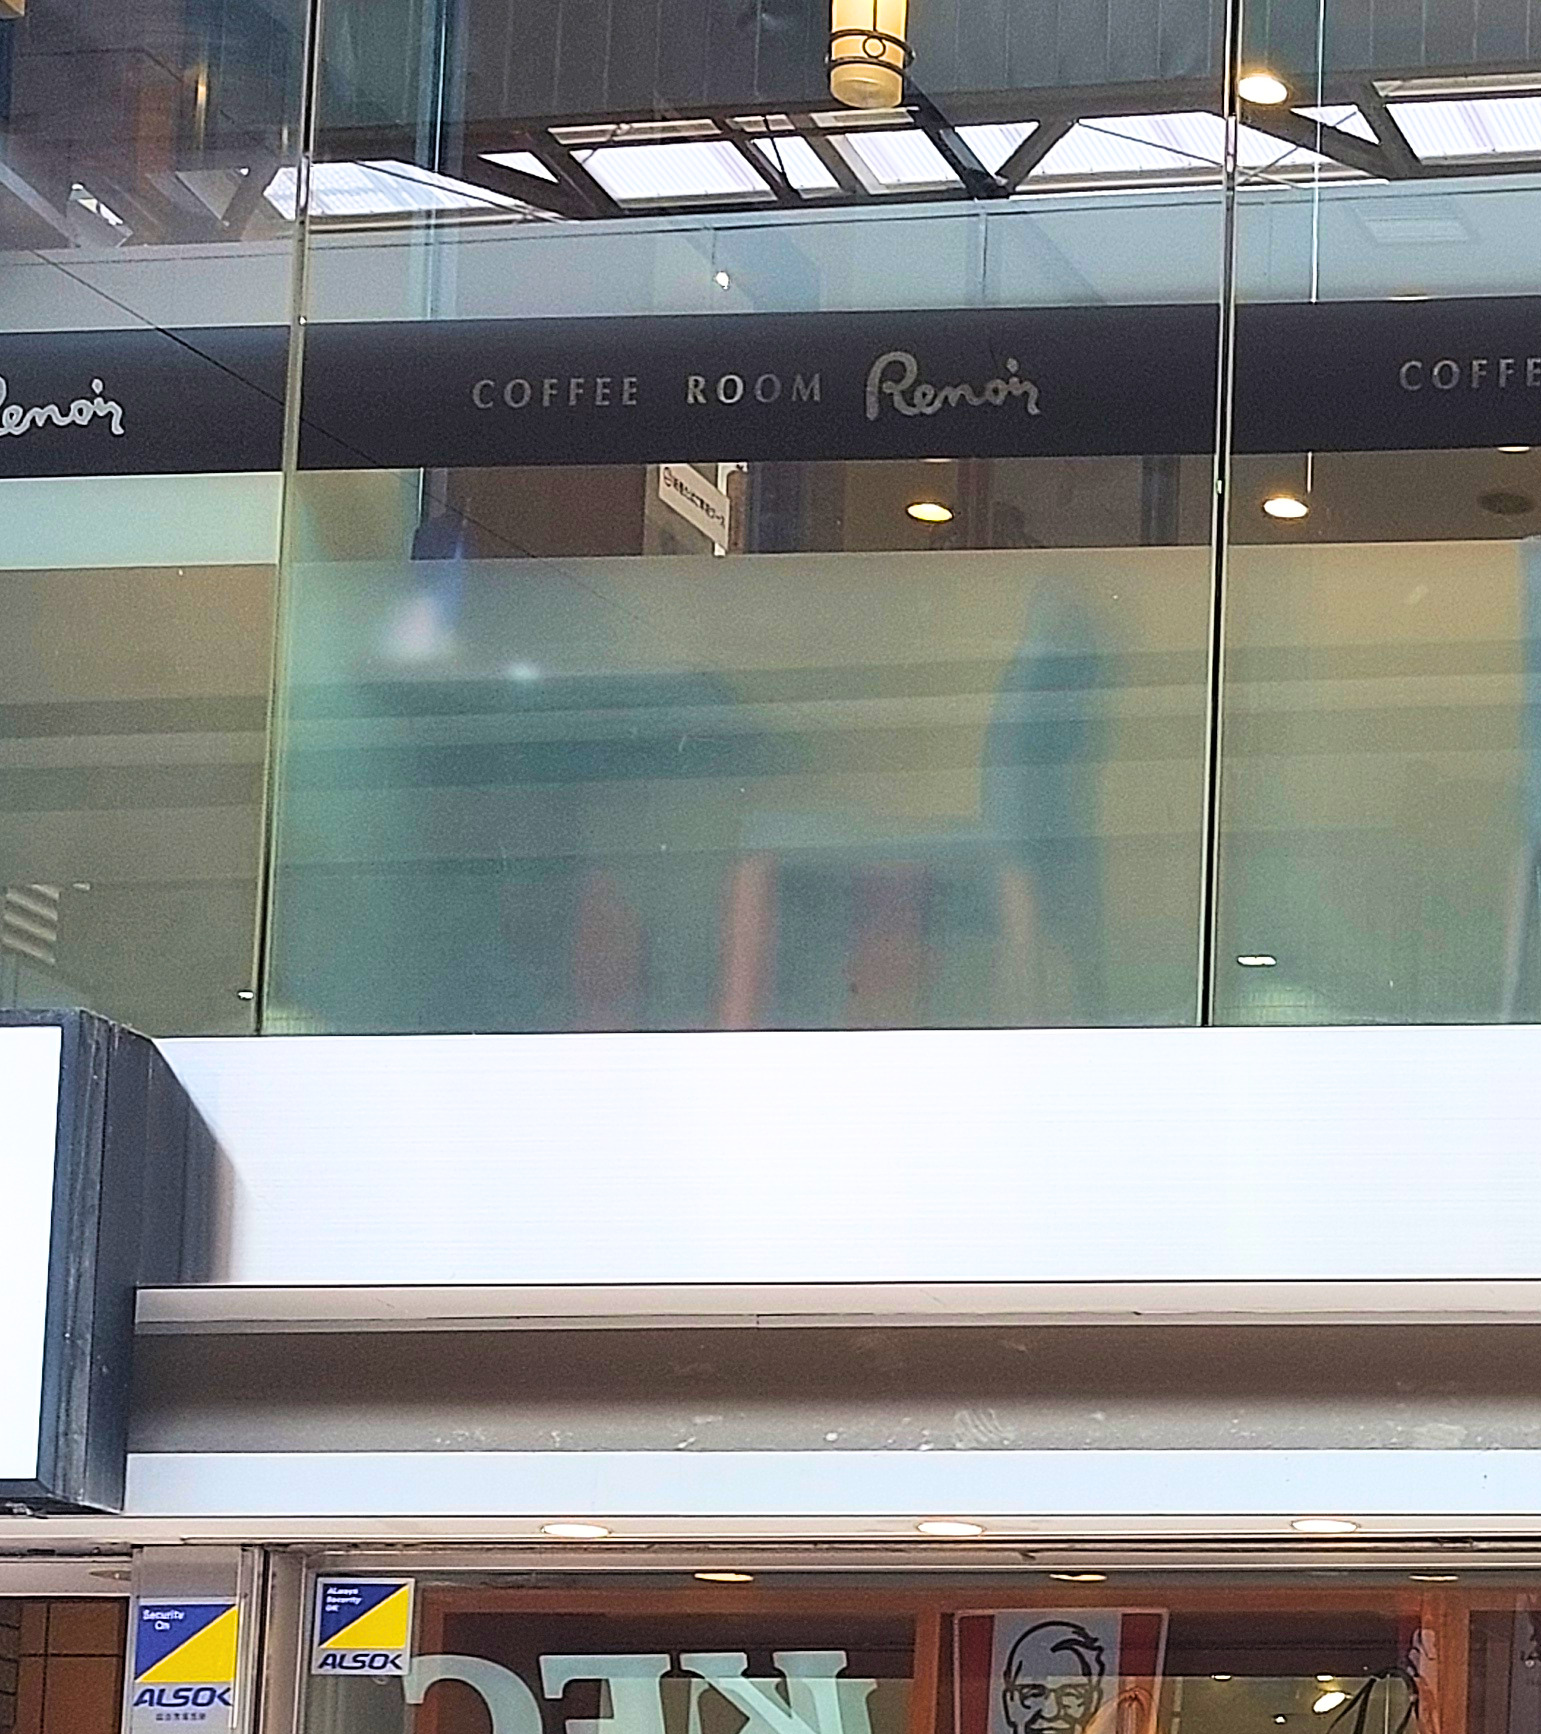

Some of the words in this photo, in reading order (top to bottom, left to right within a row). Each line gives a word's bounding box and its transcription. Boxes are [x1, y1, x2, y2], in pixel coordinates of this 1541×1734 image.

[471, 375, 640, 408] COFFEE
[687, 372, 824, 405] ROOM
[864, 350, 1041, 419] Renoir
[0, 376, 125, 436] enoir
[143, 1609, 185, 1621] Security
[154, 1620, 170, 1631] On
[317, 1653, 403, 1670] ALSOK
[134, 1687, 232, 1707] ALSOK
